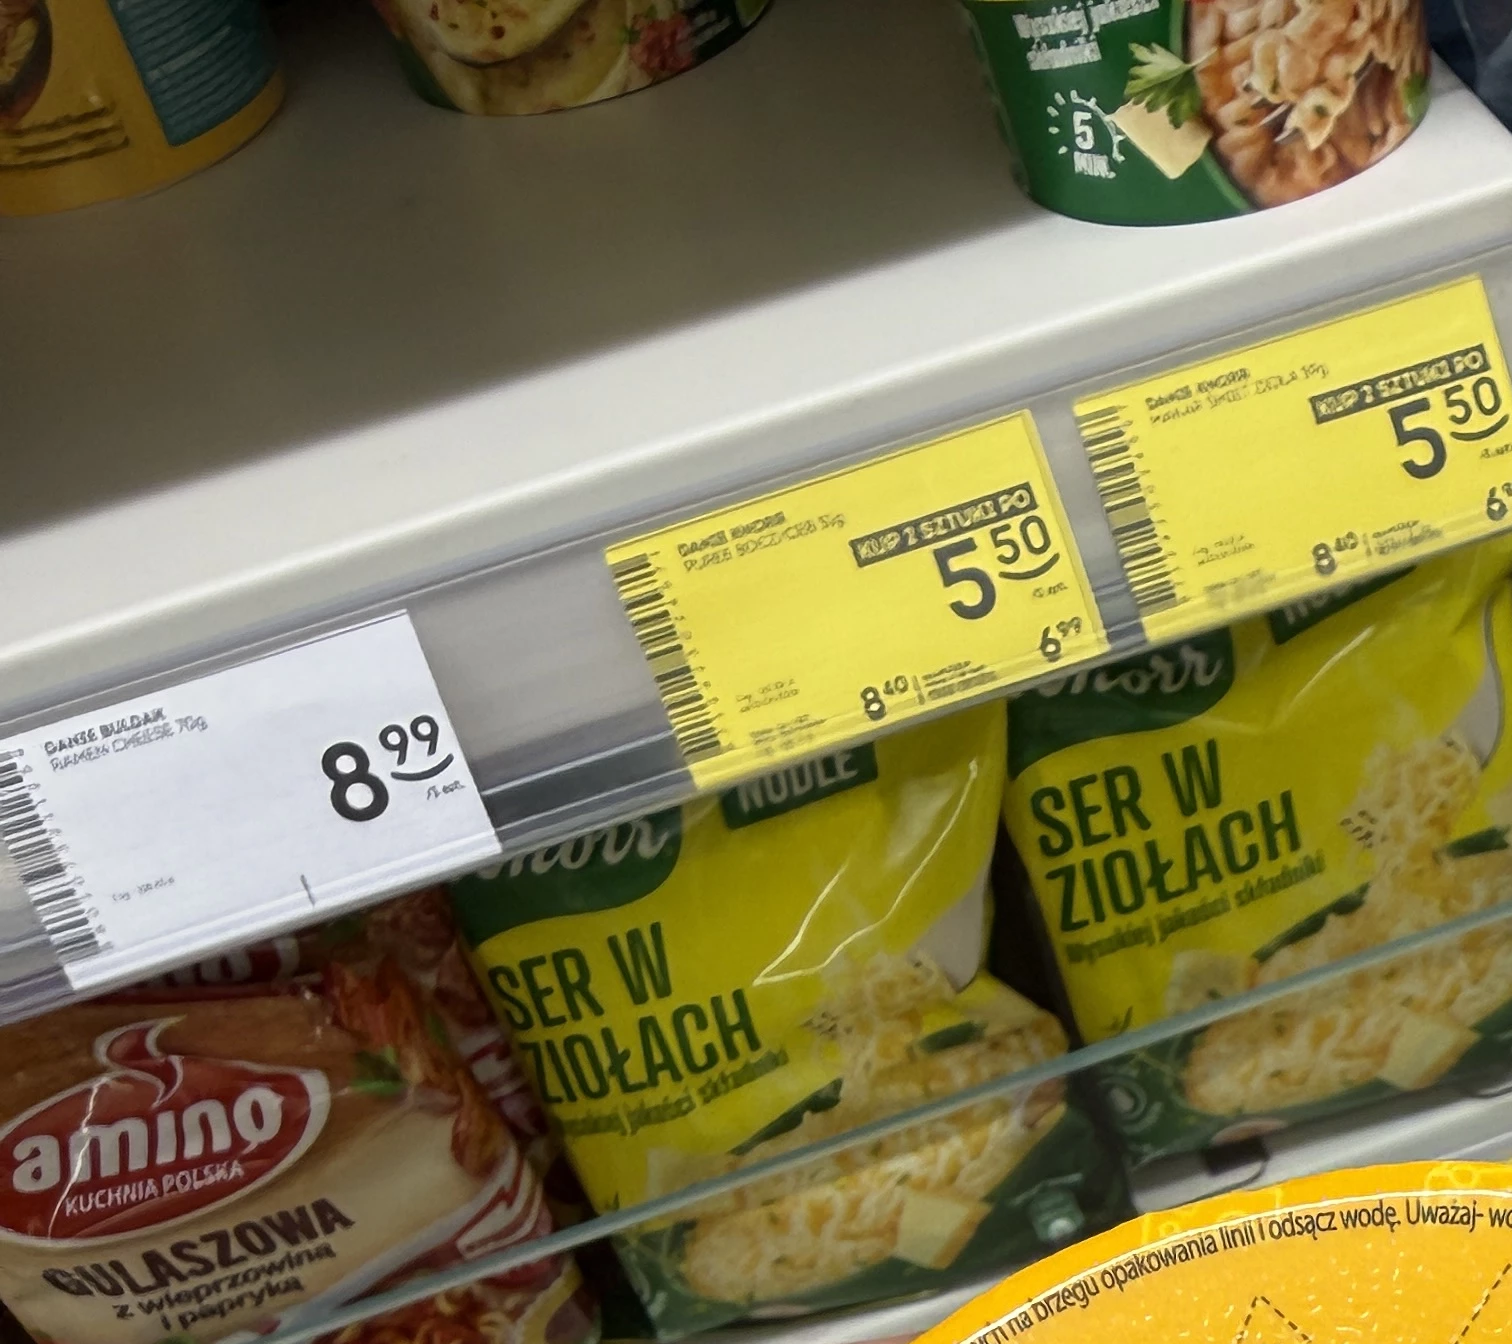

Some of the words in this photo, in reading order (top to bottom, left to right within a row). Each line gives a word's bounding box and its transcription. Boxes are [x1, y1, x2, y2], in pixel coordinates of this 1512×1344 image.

[1072, 110, 1095, 150] 5
[998, 487, 1030, 515] PO
[1028, 764, 1151, 857] SER
[1162, 738, 1224, 818] W
[1045, 789, 1300, 934] ZIOŁACH
[488, 946, 604, 1031] SER
[607, 922, 672, 1004] W
[518, 987, 762, 1105] ZIOŁACH
[12, 1086, 284, 1193] amino
[64, 1180, 158, 1217] KUCHNIA
[162, 1160, 245, 1197] POLSKA
[42, 1197, 355, 1298] GULASZOWA
[1008, 1309, 1033, 1336] na
[1026, 1274, 1100, 1324] brzegu
[1100, 1233, 1219, 1292] opakowania
[1219, 1222, 1258, 1250] linii
[1268, 1210, 1338, 1241] odsącz
[1340, 1198, 1401, 1233] wodę.
